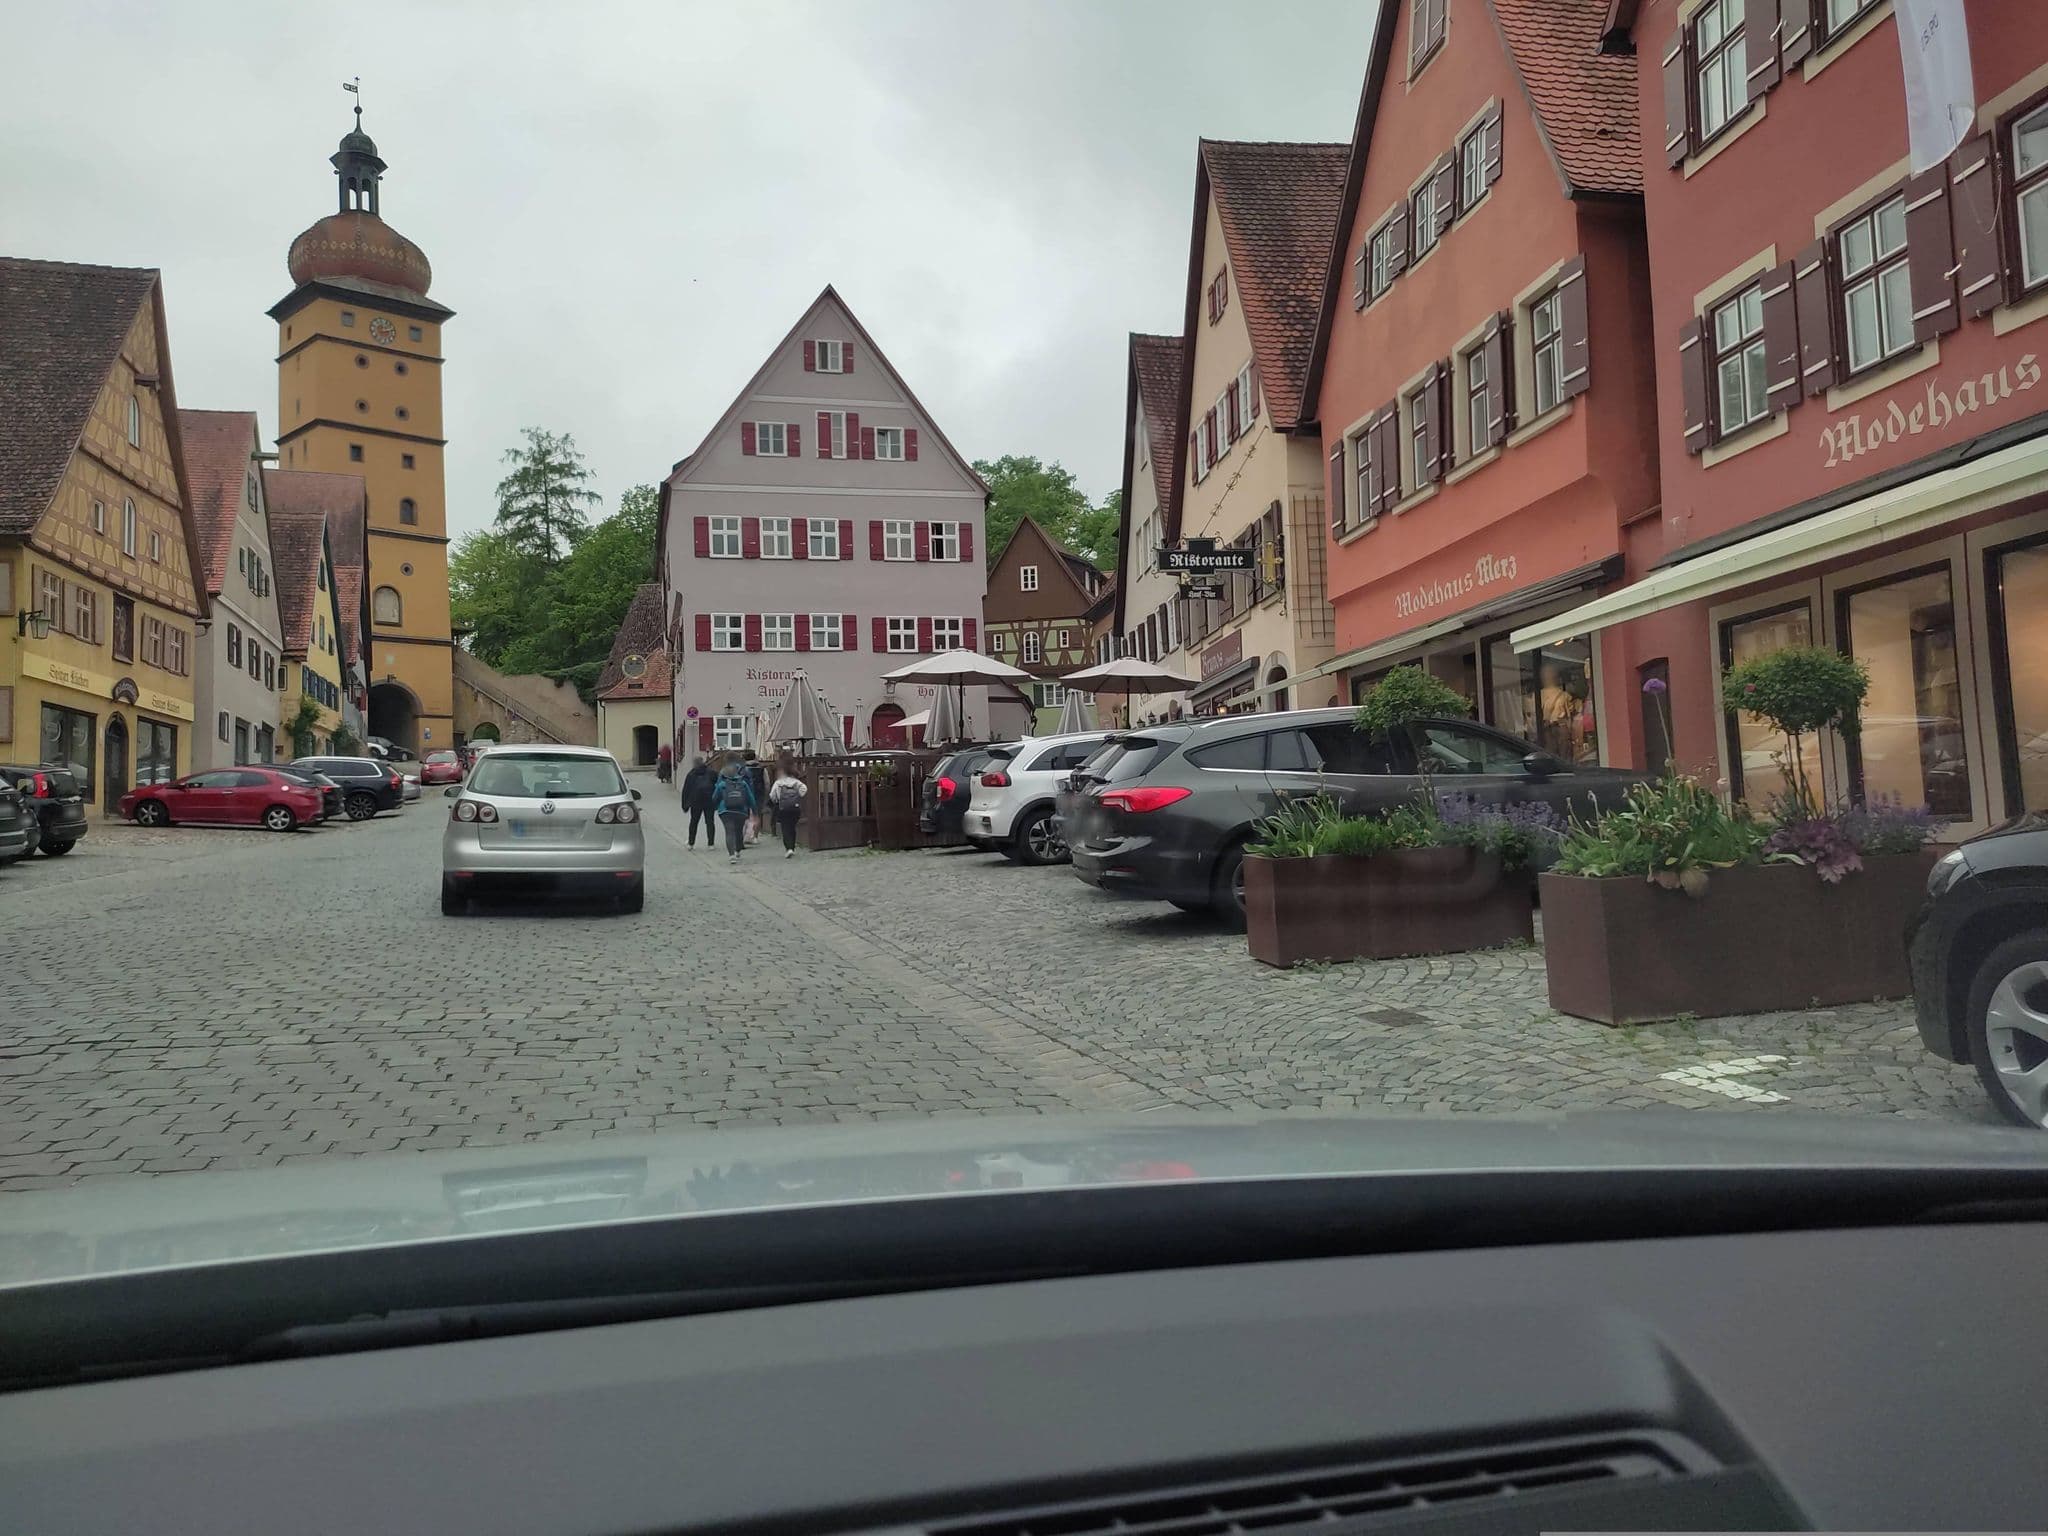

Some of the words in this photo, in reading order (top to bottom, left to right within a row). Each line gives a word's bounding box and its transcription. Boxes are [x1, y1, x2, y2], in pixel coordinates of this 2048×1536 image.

[1819, 354, 2042, 468] Modehaus
[1169, 553, 1244, 567] Ristorante
[1394, 573, 1473, 618] Modehaus
[1475, 554, 1517, 586] Merz
[746, 668, 808, 680] Ristora
